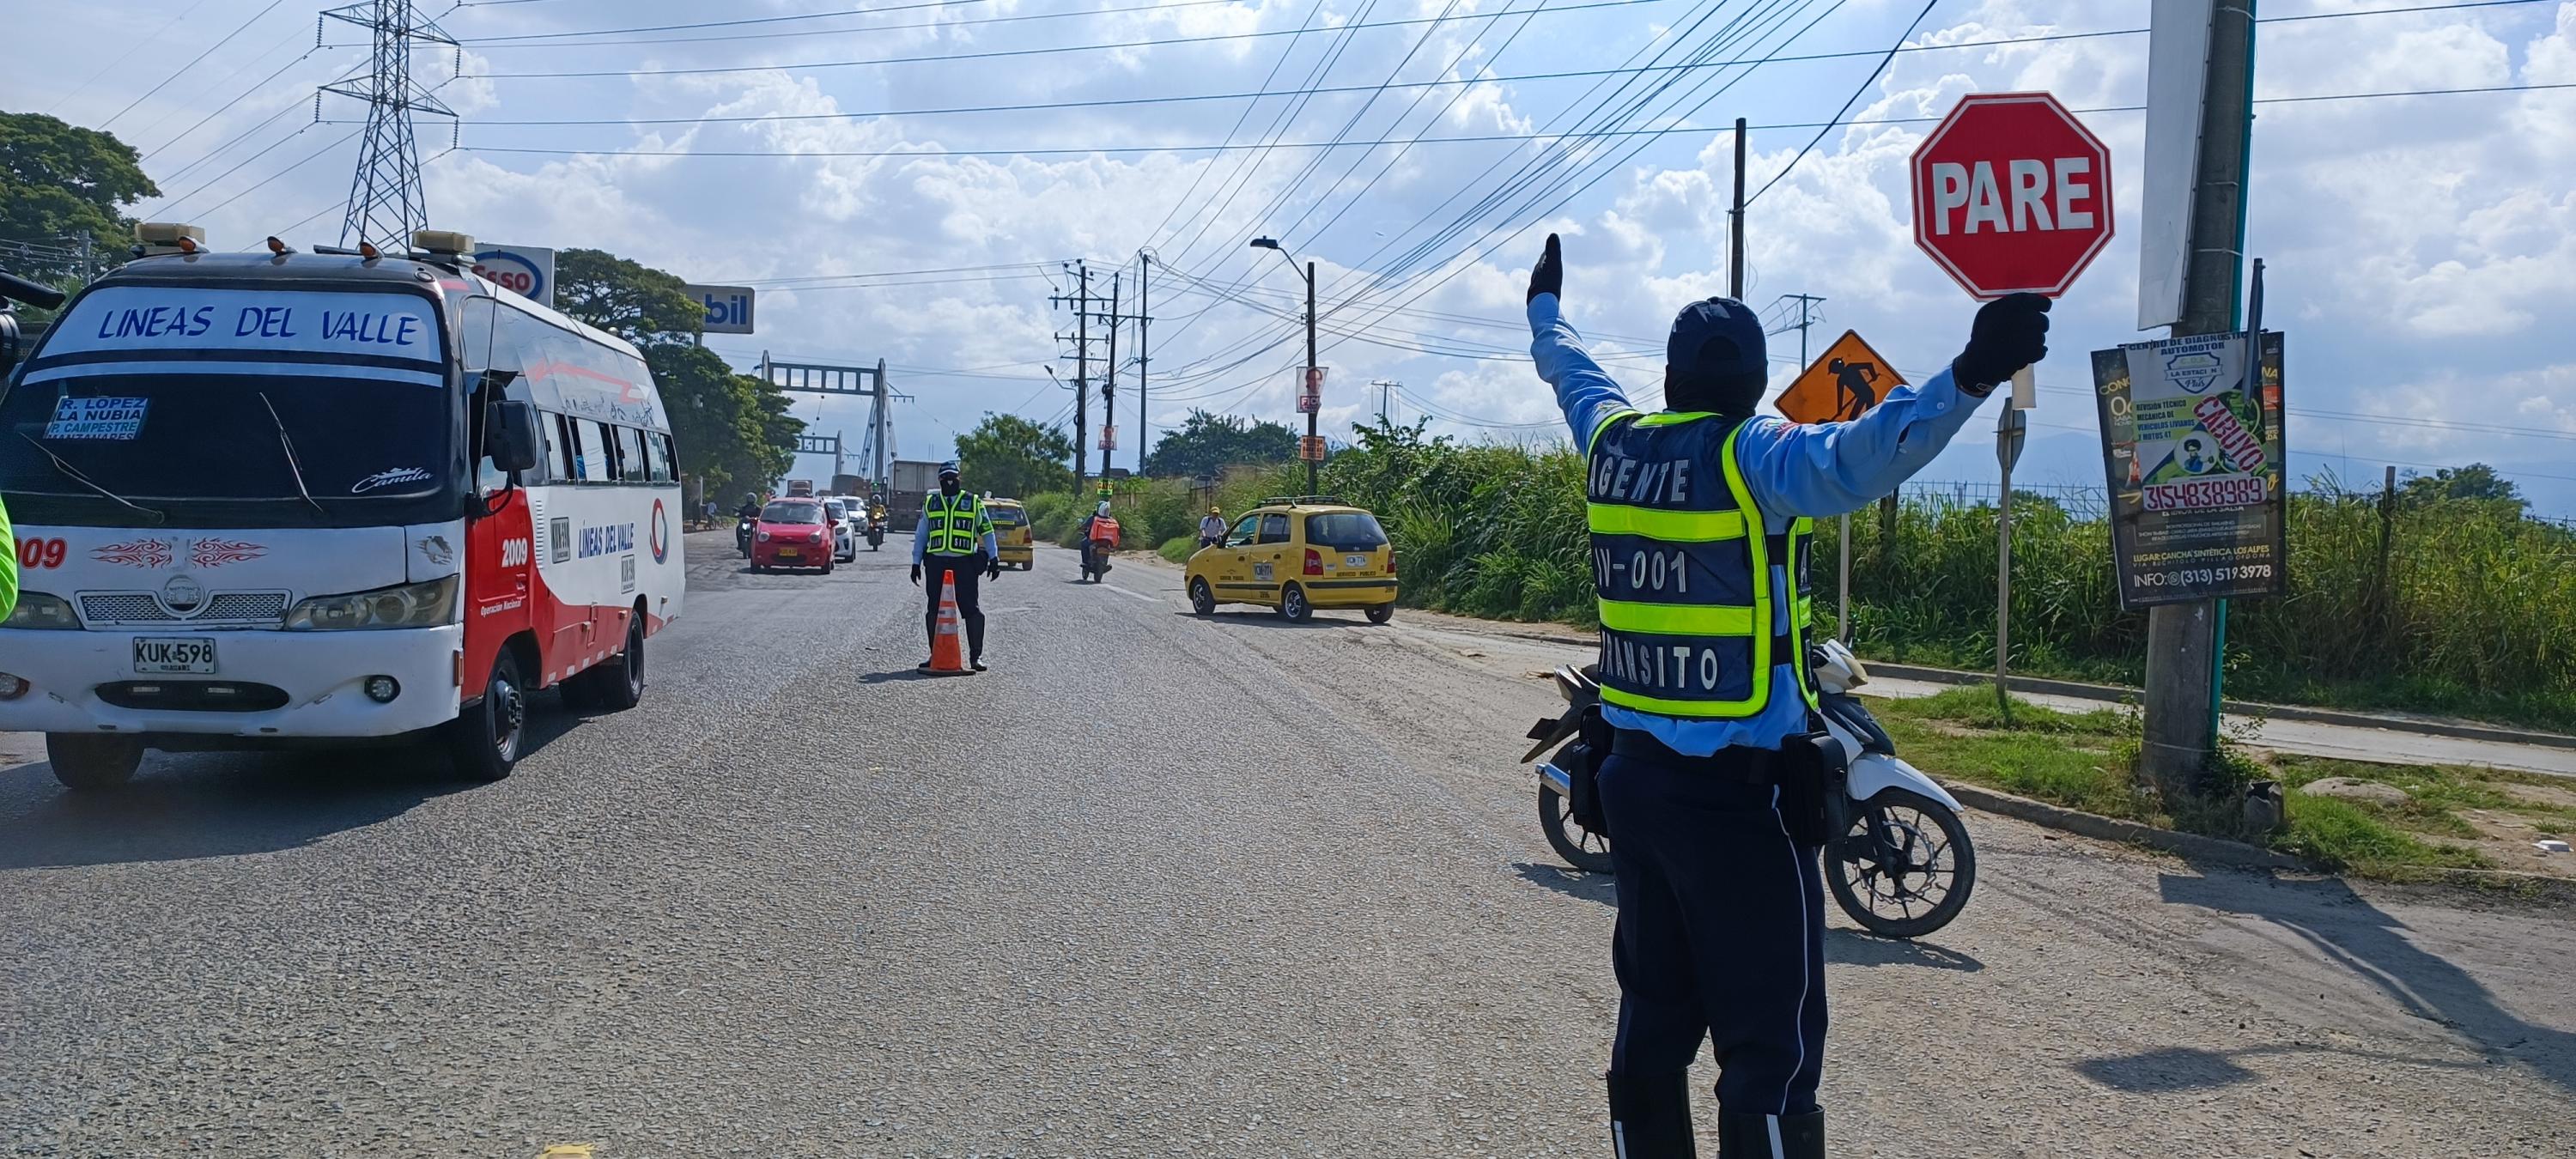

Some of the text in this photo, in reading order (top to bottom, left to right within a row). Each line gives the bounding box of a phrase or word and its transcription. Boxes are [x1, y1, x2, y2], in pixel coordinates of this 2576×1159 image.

[1932, 157, 2093, 235] PARE
[705, 294, 747, 325] bil
[98, 306, 421, 345] LINEAS DEL VALLE
[2129, 339, 2166, 350] CENTRO
[2184, 332, 2248, 344] DIAGNOSTIC
[2160, 342, 2225, 355] AUTOMOTOR
[2182, 367, 2217, 376] ESTACIN
[56, 410, 141, 421] LA NUBIA
[60, 397, 147, 410] R. LOPEZ
[64, 422, 137, 433] CAMPESTRE
[2169, 419, 2195, 428] LIVIANOS
[2193, 396, 2264, 471] CABUYO
[351, 468, 434, 494] Camila
[1589, 453, 1689, 504] AGENTE
[2144, 477, 2263, 510] 3154838989
[501, 537, 528, 567] 2009
[579, 519, 635, 559] LÍNEAS DEL VALLE
[2161, 550, 2191, 561] CANCHA
[2233, 546, 2246, 555] LOS
[2248, 544, 2269, 554] ALPES
[2134, 564, 2272, 587] INFO: (313) 519 3978
[1600, 629, 1718, 690] TRANSITO
